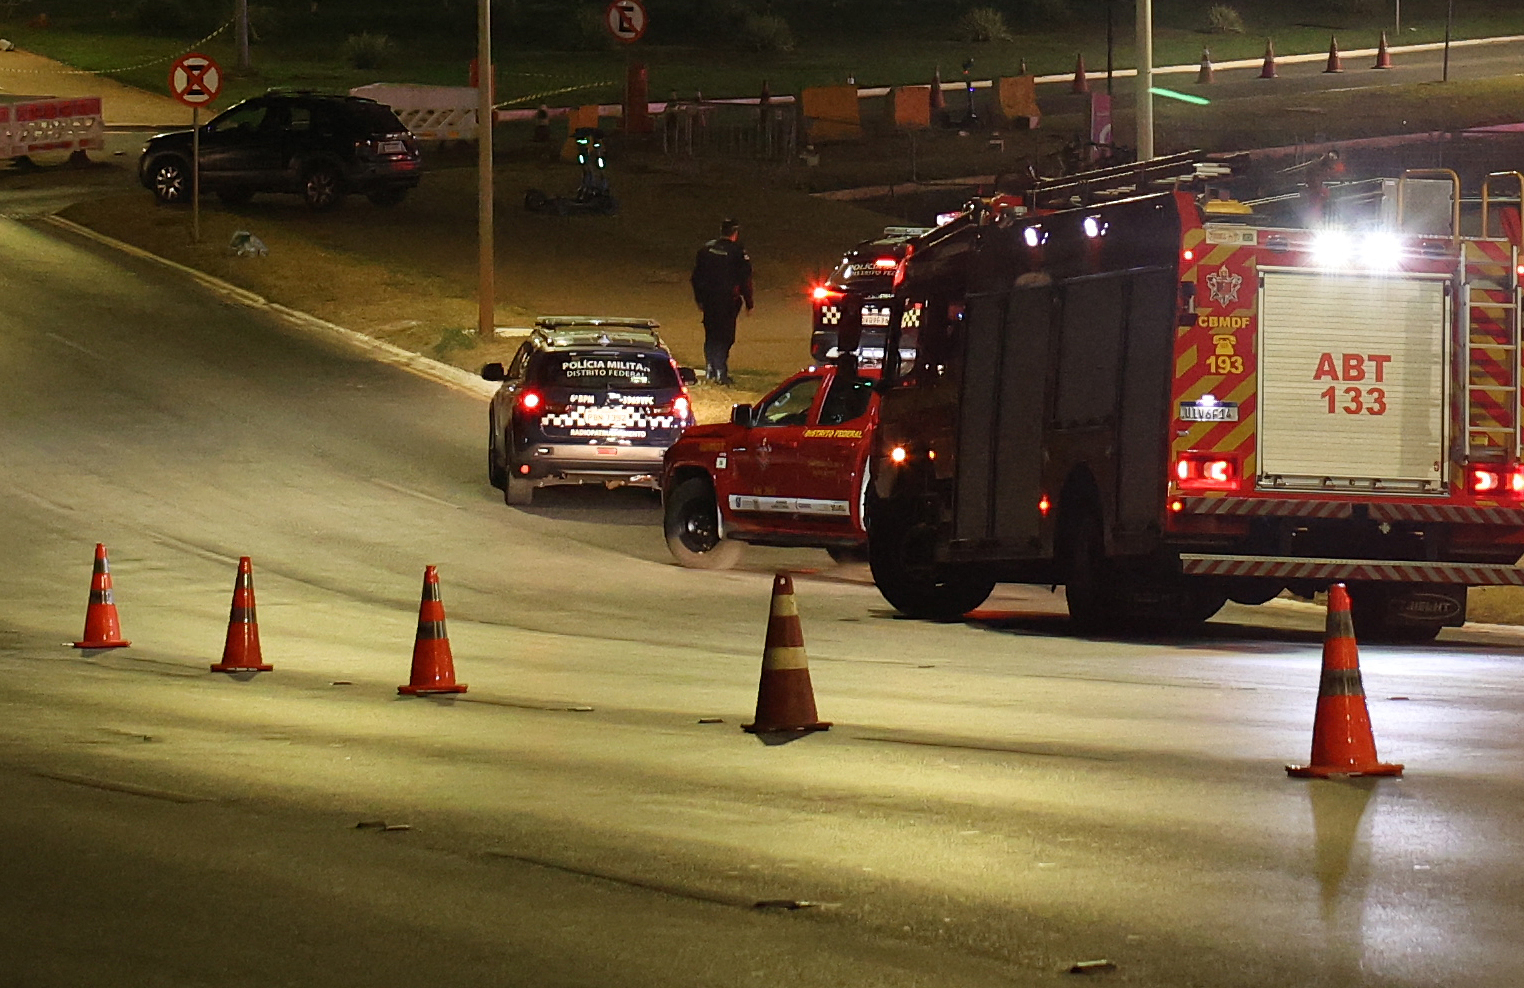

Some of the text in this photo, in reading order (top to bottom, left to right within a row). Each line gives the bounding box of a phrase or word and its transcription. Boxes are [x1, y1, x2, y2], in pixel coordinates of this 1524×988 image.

[1198, 316, 1250, 328] CBMDF
[562, 359, 605, 370] POLÍCIA
[1206, 355, 1244, 374] 193
[1312, 352, 1392, 383] ABT
[566, 369, 606, 378] DISTRITO
[1320, 385, 1387, 416] 133
